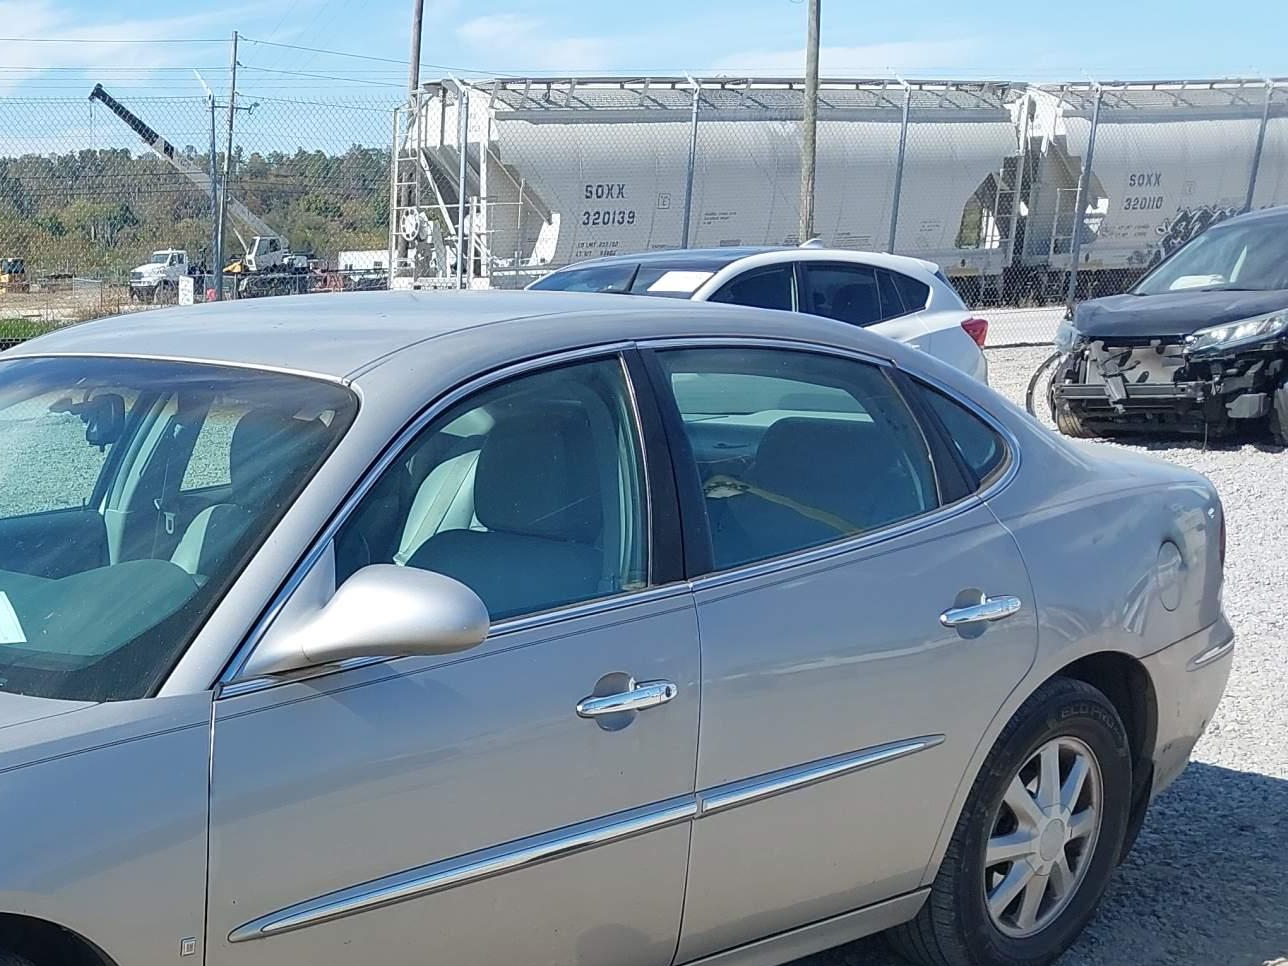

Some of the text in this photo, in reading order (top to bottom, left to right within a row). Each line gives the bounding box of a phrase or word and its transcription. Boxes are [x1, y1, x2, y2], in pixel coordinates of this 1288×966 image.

[1129, 173, 1162, 187] SOXX
[585, 184, 625, 199] SOXX
[1124, 196, 1163, 210] 320110
[582, 210, 636, 226] 320139
